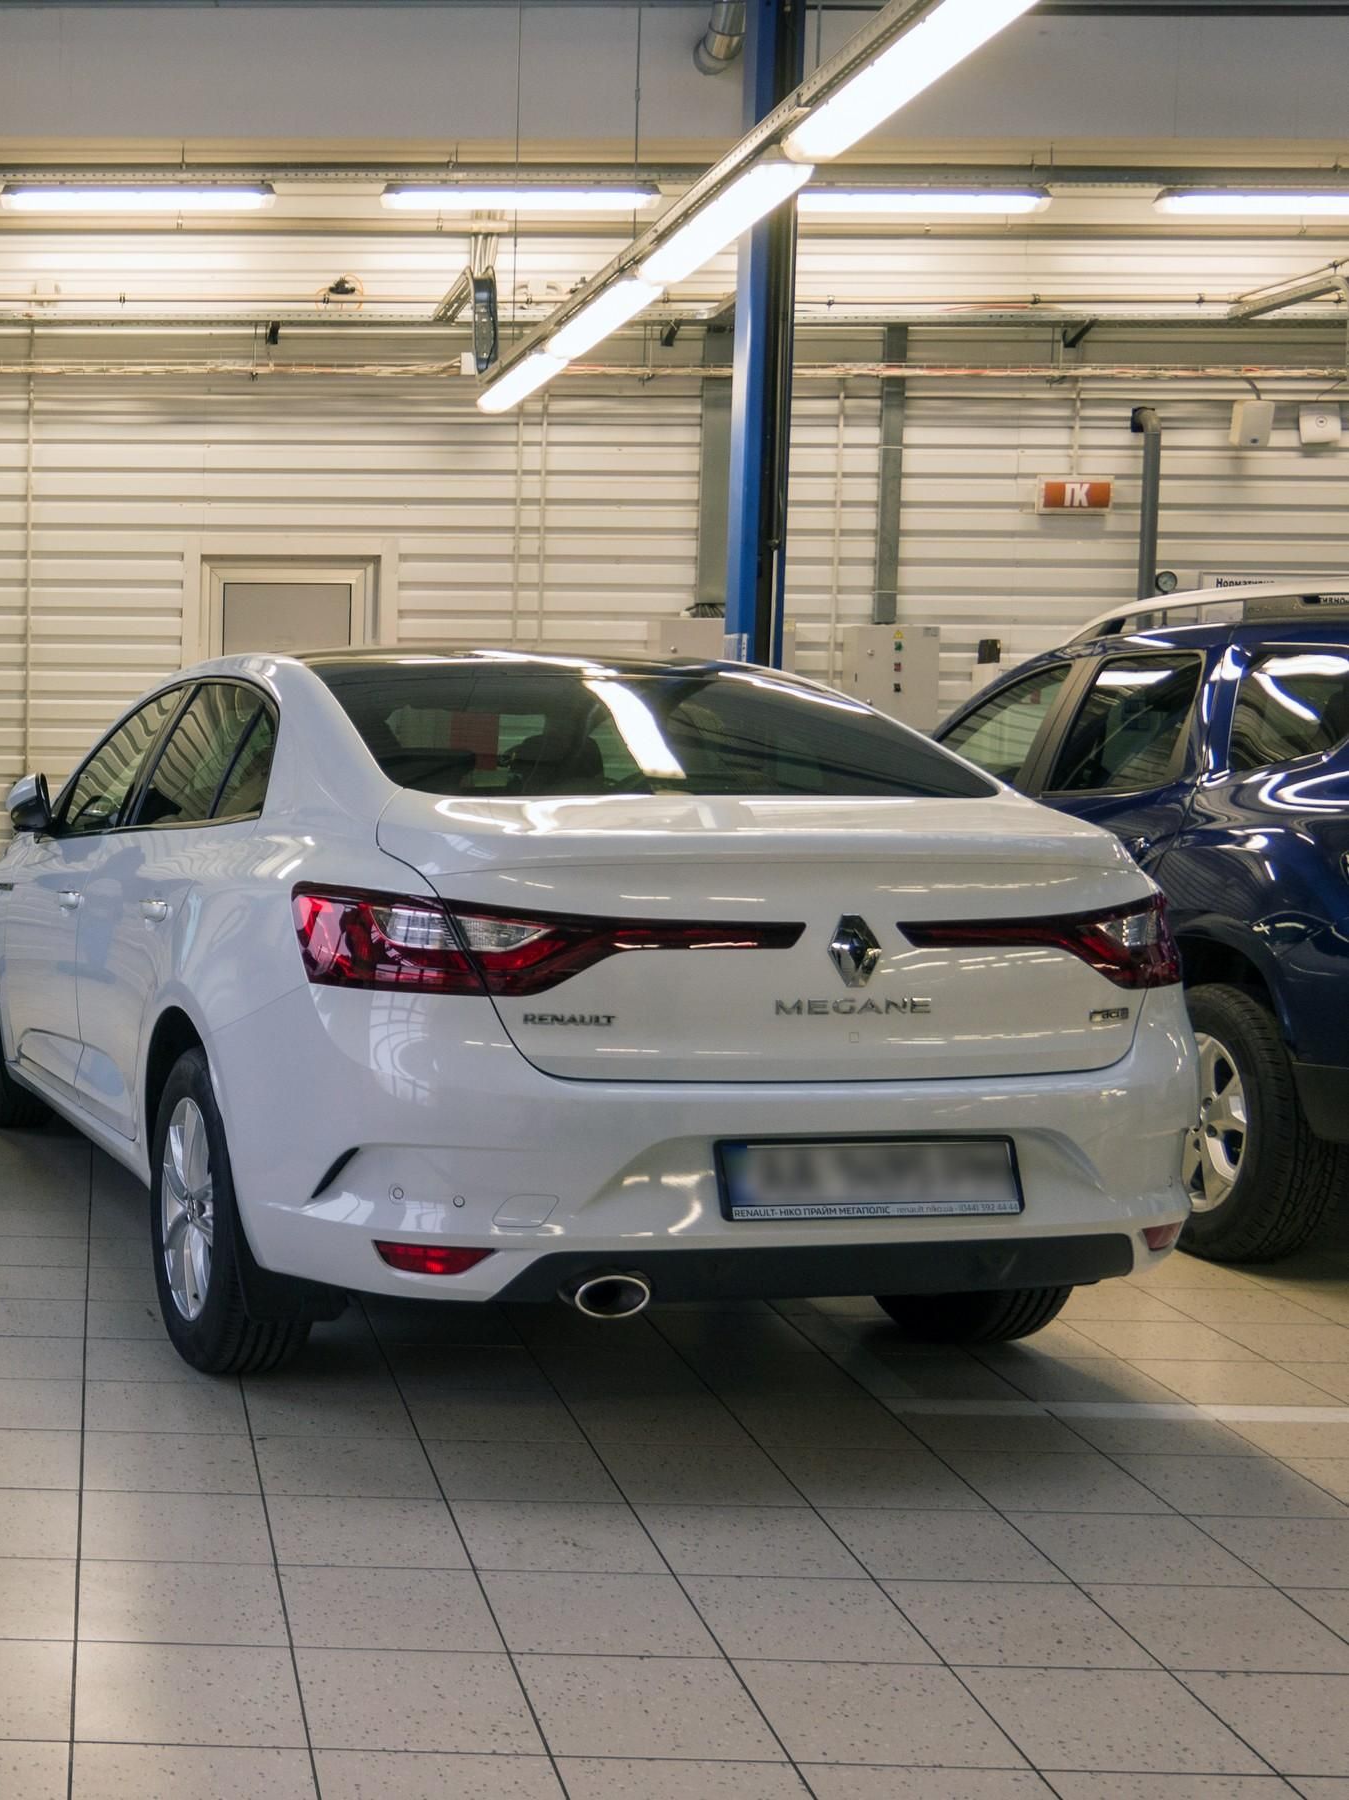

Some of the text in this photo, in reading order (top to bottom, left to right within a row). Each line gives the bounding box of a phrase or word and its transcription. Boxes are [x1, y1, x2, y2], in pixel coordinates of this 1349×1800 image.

[1063, 483, 1091, 507] ПК
[774, 998, 932, 1015] MEGANE
[523, 1013, 616, 1026] RENAULT
[803, 1205, 837, 1216] ПРАЙМ
[838, 1205, 890, 1215] МЕГАПОЛІС
